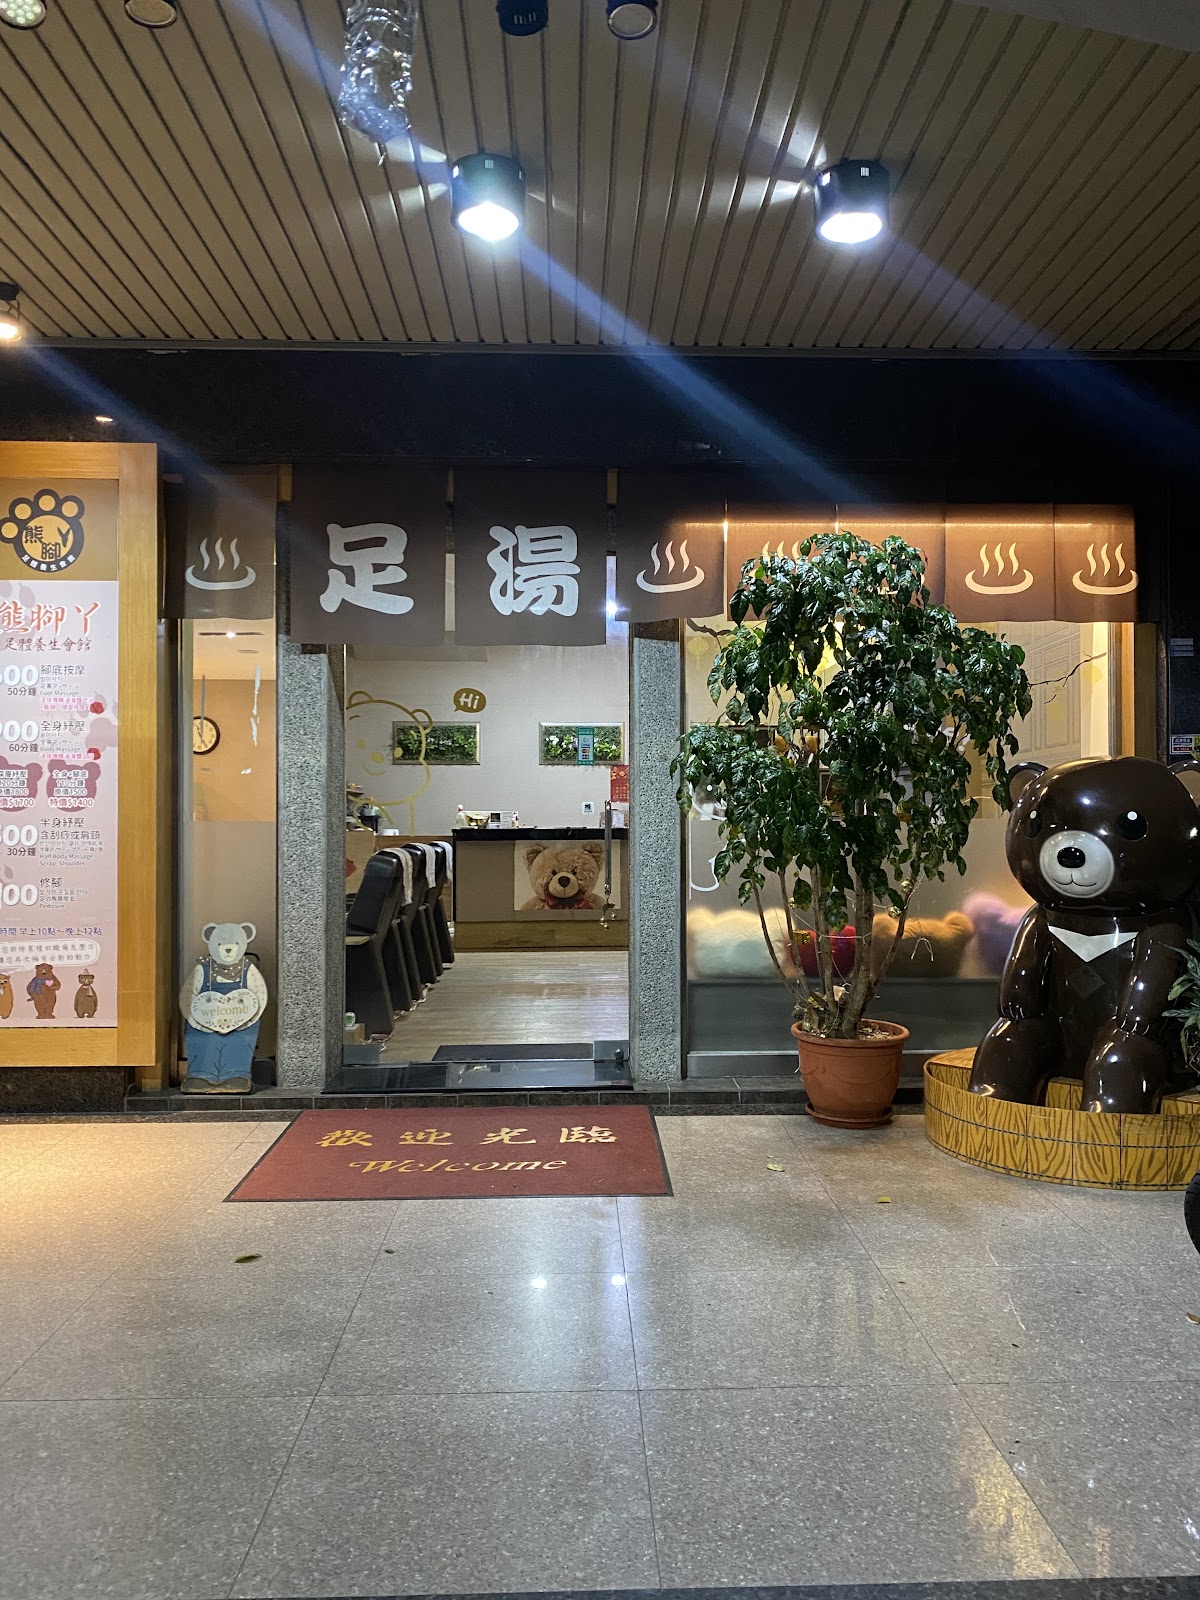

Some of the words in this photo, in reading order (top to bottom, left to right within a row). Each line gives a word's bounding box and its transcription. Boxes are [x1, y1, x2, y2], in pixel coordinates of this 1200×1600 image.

[24, 525, 71, 560] 熊腳丫
[319, 523, 581, 617] 足湯
[4, 636, 92, 652] 足體養生會館
[0, 664, 39, 687] 00
[40, 664, 86, 675] 腳底按摩
[7, 686, 37, 696] 50分鐘
[458, 692, 480, 710] Hi
[0, 720, 39, 742] 00
[40, 720, 85, 732] 全身紓壓
[9, 743, 38, 753] 60分鐘
[40, 817, 85, 828] 半身紓壓
[0, 824, 38, 847] 00
[7, 847, 36, 857] 30分鐘
[40, 877, 62, 888] 修腳
[201, 1005, 249, 1017] welcome
[315, 1125, 618, 1147] 歡迎光臨
[348, 1158, 568, 1173] Welcome
